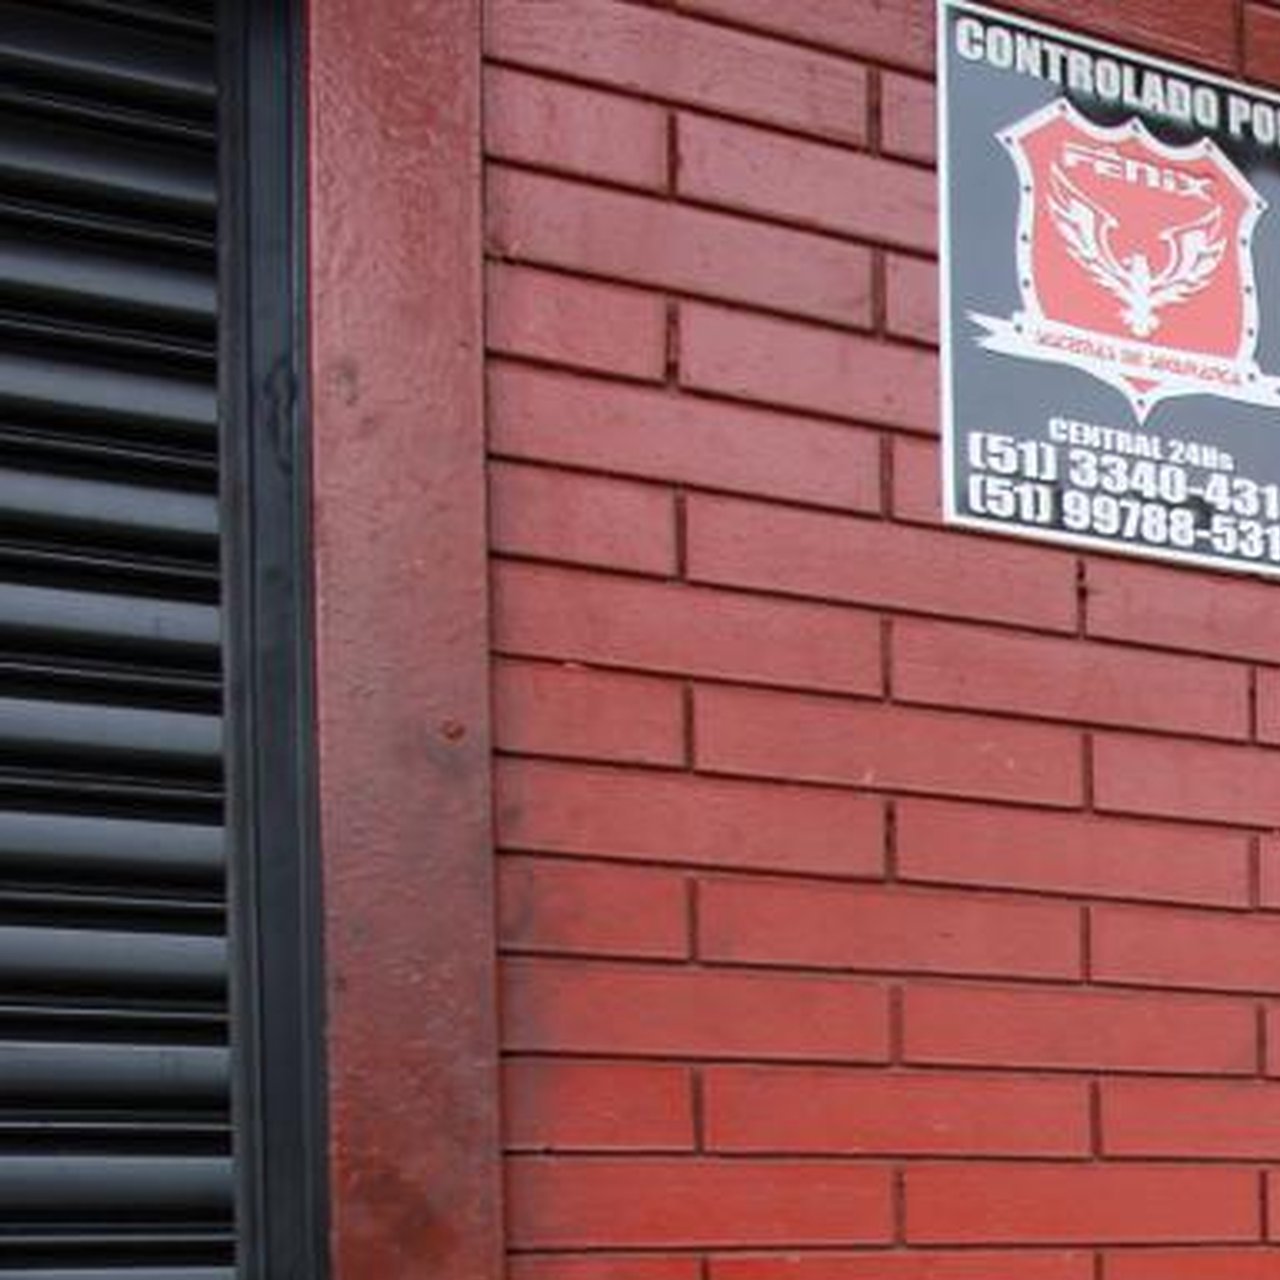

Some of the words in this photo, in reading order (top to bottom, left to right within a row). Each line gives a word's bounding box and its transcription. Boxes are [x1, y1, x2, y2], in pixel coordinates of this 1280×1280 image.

[955, 16, 1219, 128] CONTROLADO
[968, 431, 1057, 481] (51)
[1050, 418, 1163, 461] CENTRAL
[968, 474, 1050, 523] (51)
